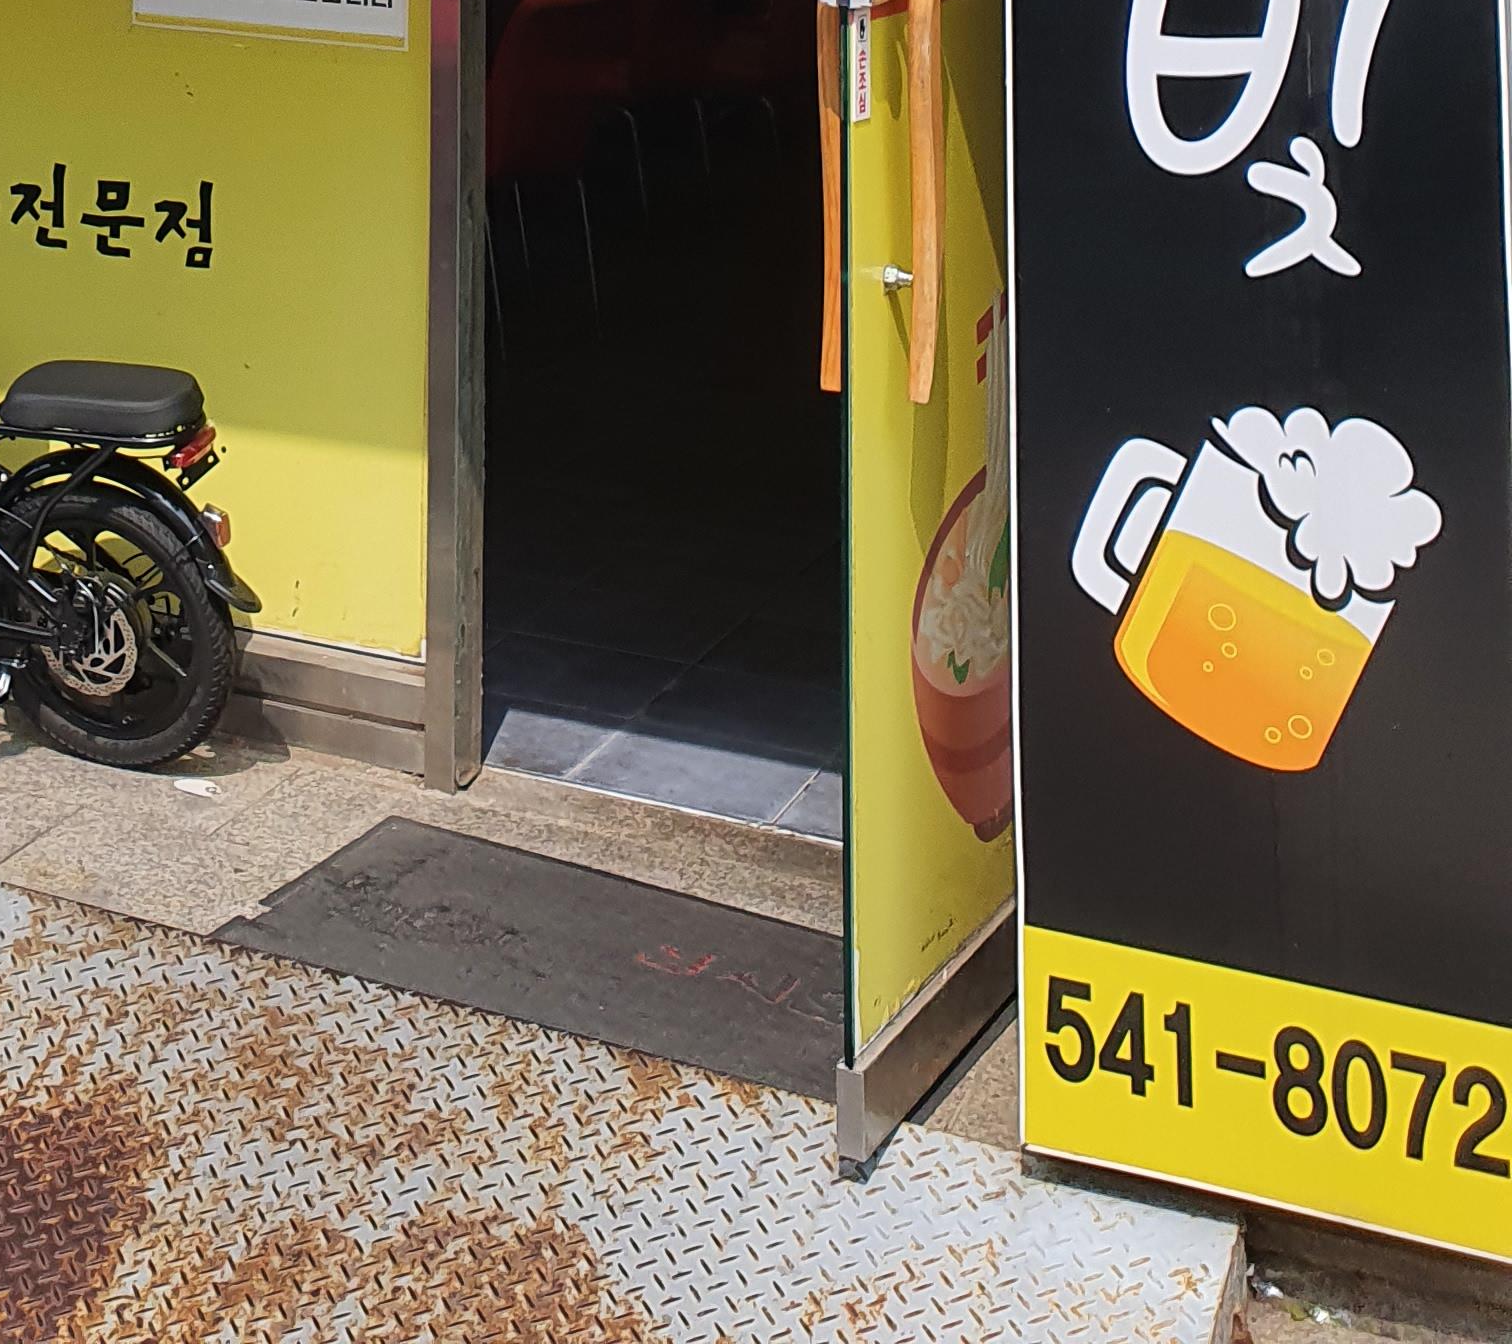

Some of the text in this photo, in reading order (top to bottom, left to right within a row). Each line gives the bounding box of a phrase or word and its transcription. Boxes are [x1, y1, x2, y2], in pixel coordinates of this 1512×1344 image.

[858, 50, 868, 114] 손조심
[9, 162, 214, 269] 전문점
[1043, 974, 1511, 1180] 541-8072
